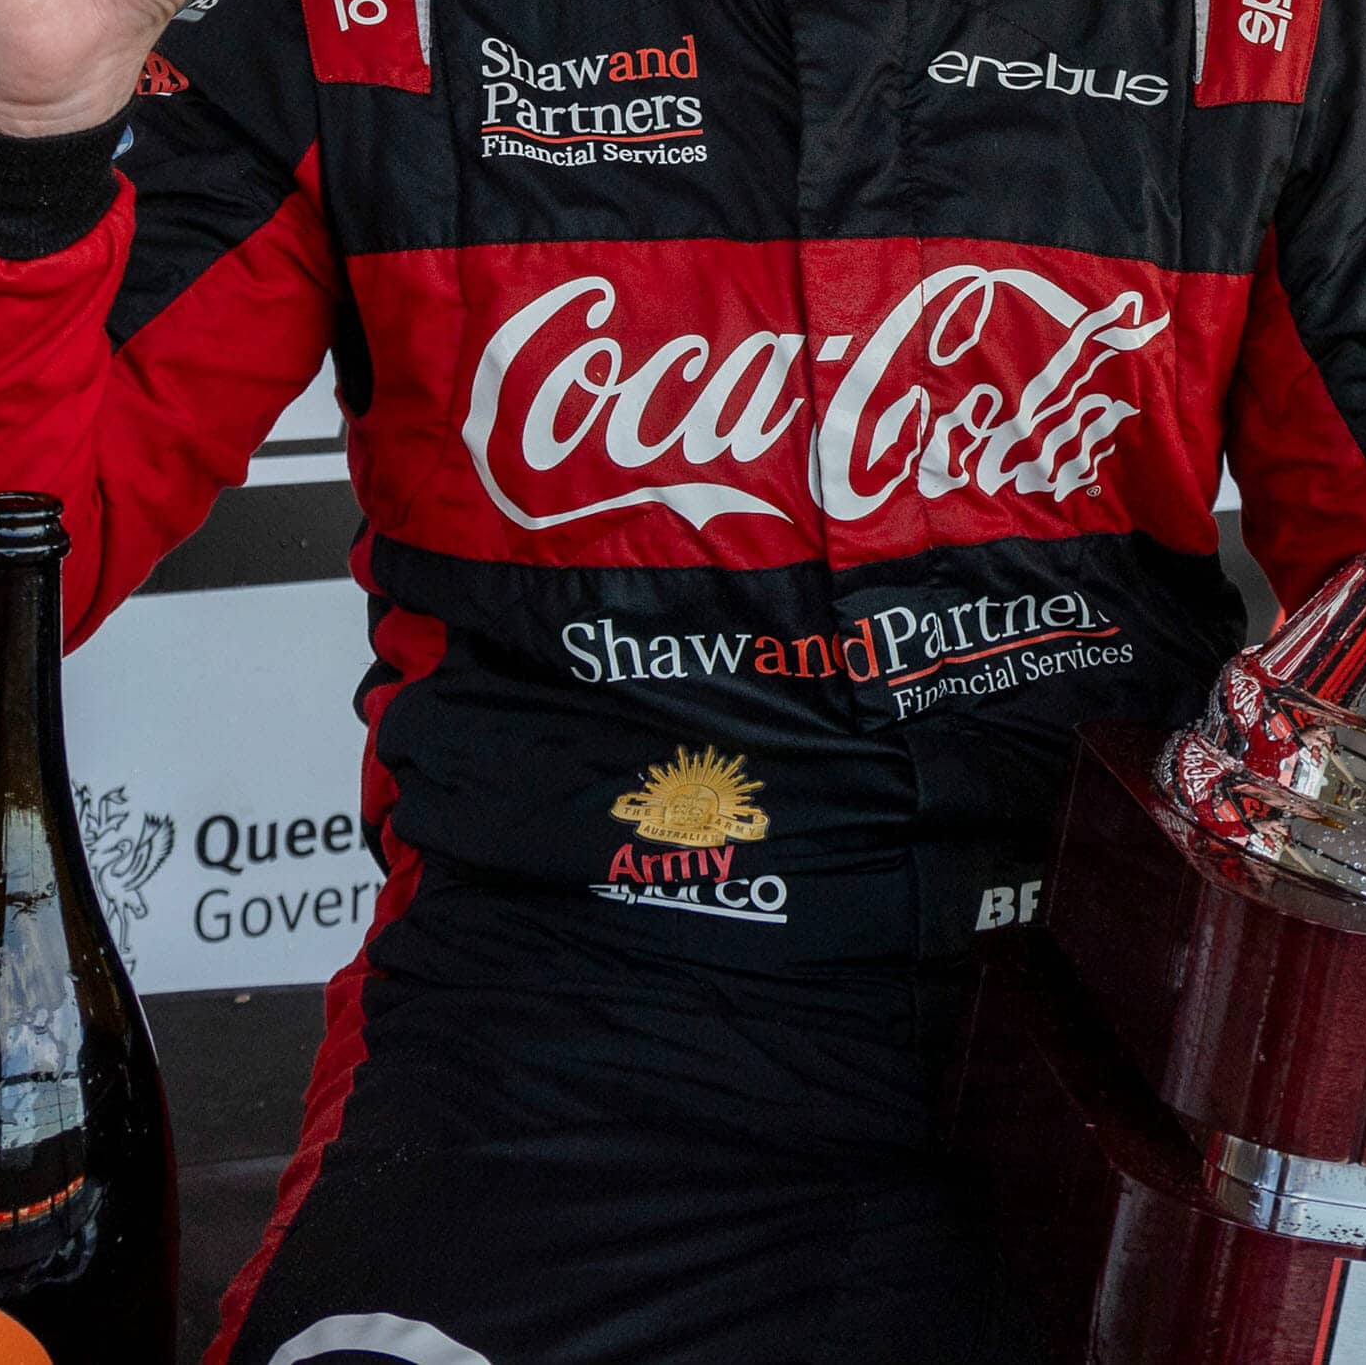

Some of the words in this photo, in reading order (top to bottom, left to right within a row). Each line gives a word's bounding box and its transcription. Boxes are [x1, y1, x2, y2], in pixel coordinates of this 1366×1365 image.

[927, 50, 1169, 107] erebus
[482, 82, 703, 136] Partners
[481, 135, 596, 167] Financial
[602, 143, 708, 165] Services
[462, 264, 1170, 530] Coca-Cola
[892, 655, 1019, 722] Financial
[1021, 640, 1134, 682] Services
[624, 806, 652, 817] THE
[714, 818, 756, 837] ARMY
[608, 843, 735, 884] Army
